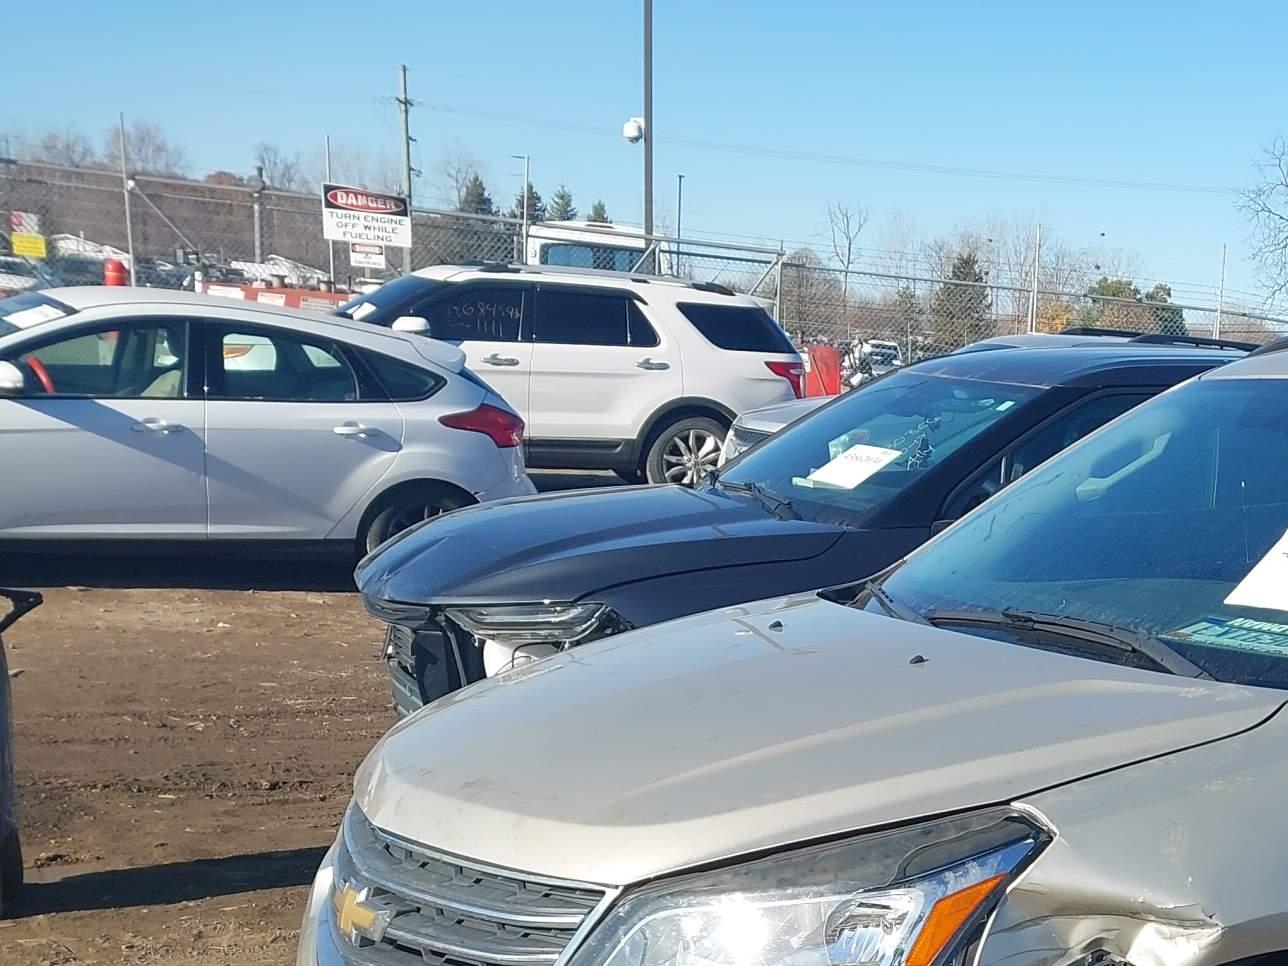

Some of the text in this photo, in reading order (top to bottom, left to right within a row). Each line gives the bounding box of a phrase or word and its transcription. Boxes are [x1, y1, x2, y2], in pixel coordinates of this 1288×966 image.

[336, 191, 396, 209] DANGER
[328, 210, 406, 226] TURN ENGINE
[336, 221, 399, 234] OFF WHILE
[343, 231, 393, 242] FUELING
